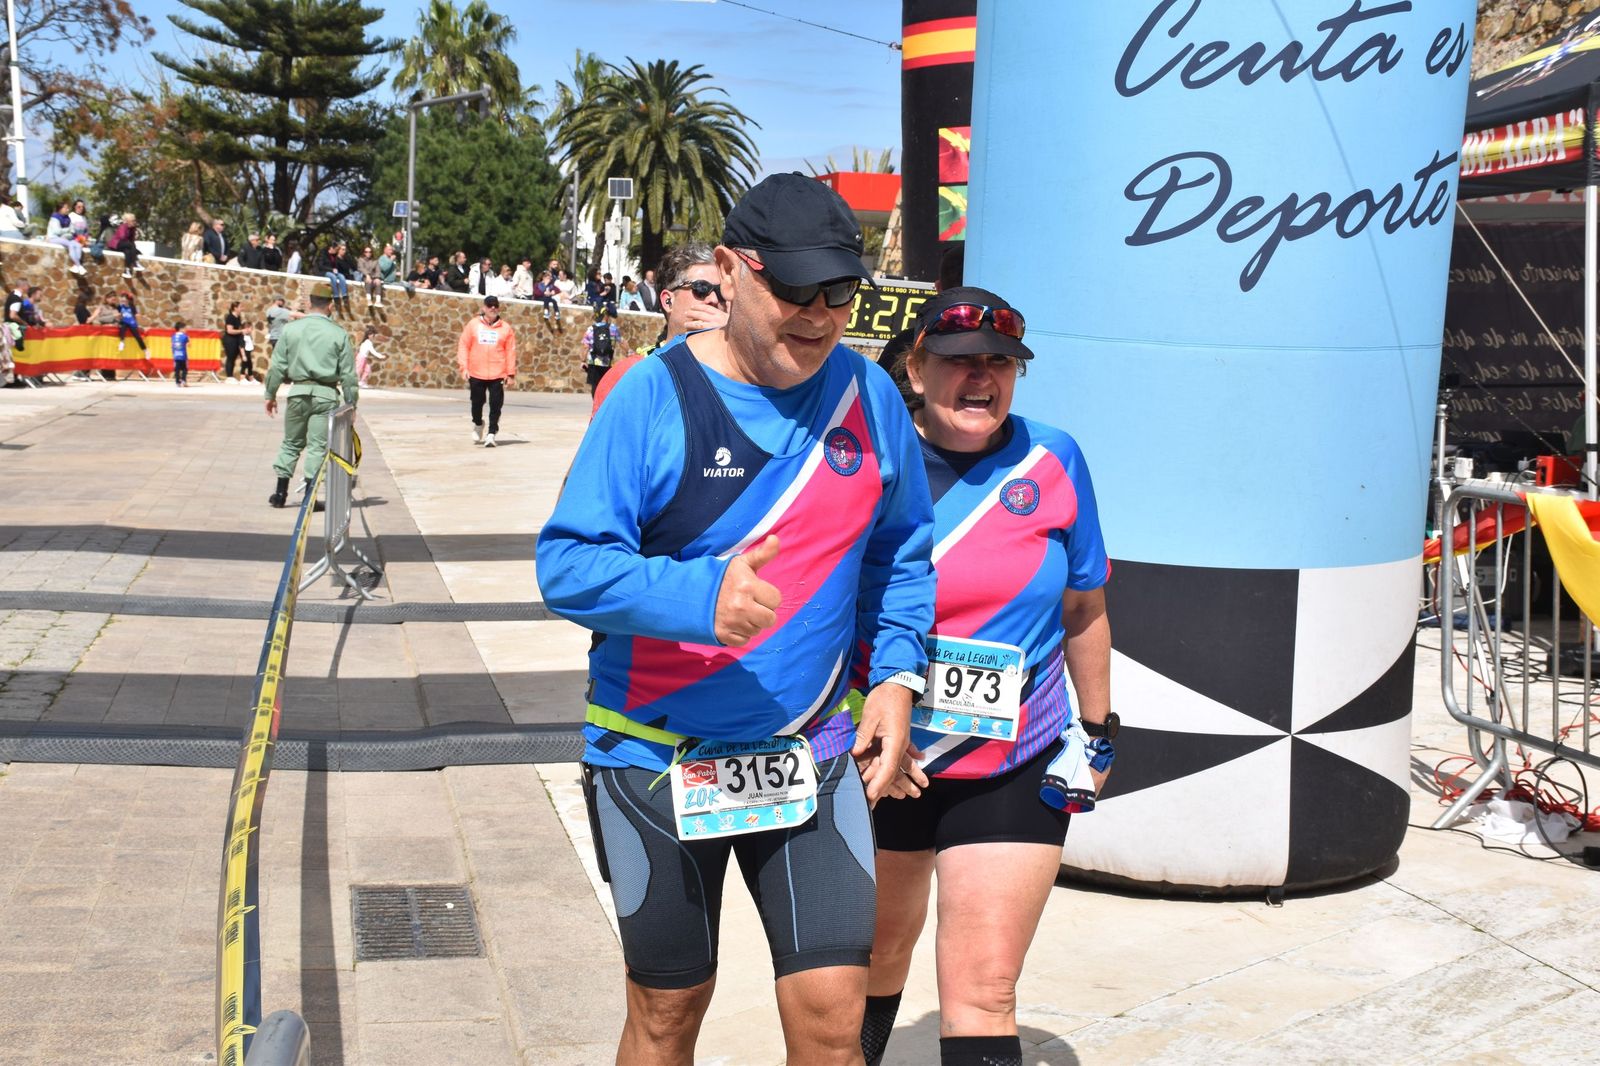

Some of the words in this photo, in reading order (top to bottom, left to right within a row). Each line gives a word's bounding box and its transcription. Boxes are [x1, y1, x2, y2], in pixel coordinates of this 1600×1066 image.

[1425, 22, 1470, 78] es
[1124, 149, 1459, 292] Deporte
[703, 467, 745, 478] VIATOR
[944, 666, 1001, 704] 973
[938, 698, 975, 708] INMACULADA
[682, 769, 697, 780] San
[696, 766, 717, 778] Pablo
[725, 752, 805, 794] 3152
[685, 786, 722, 809] 20K
[747, 792, 763, 801] JUAN
